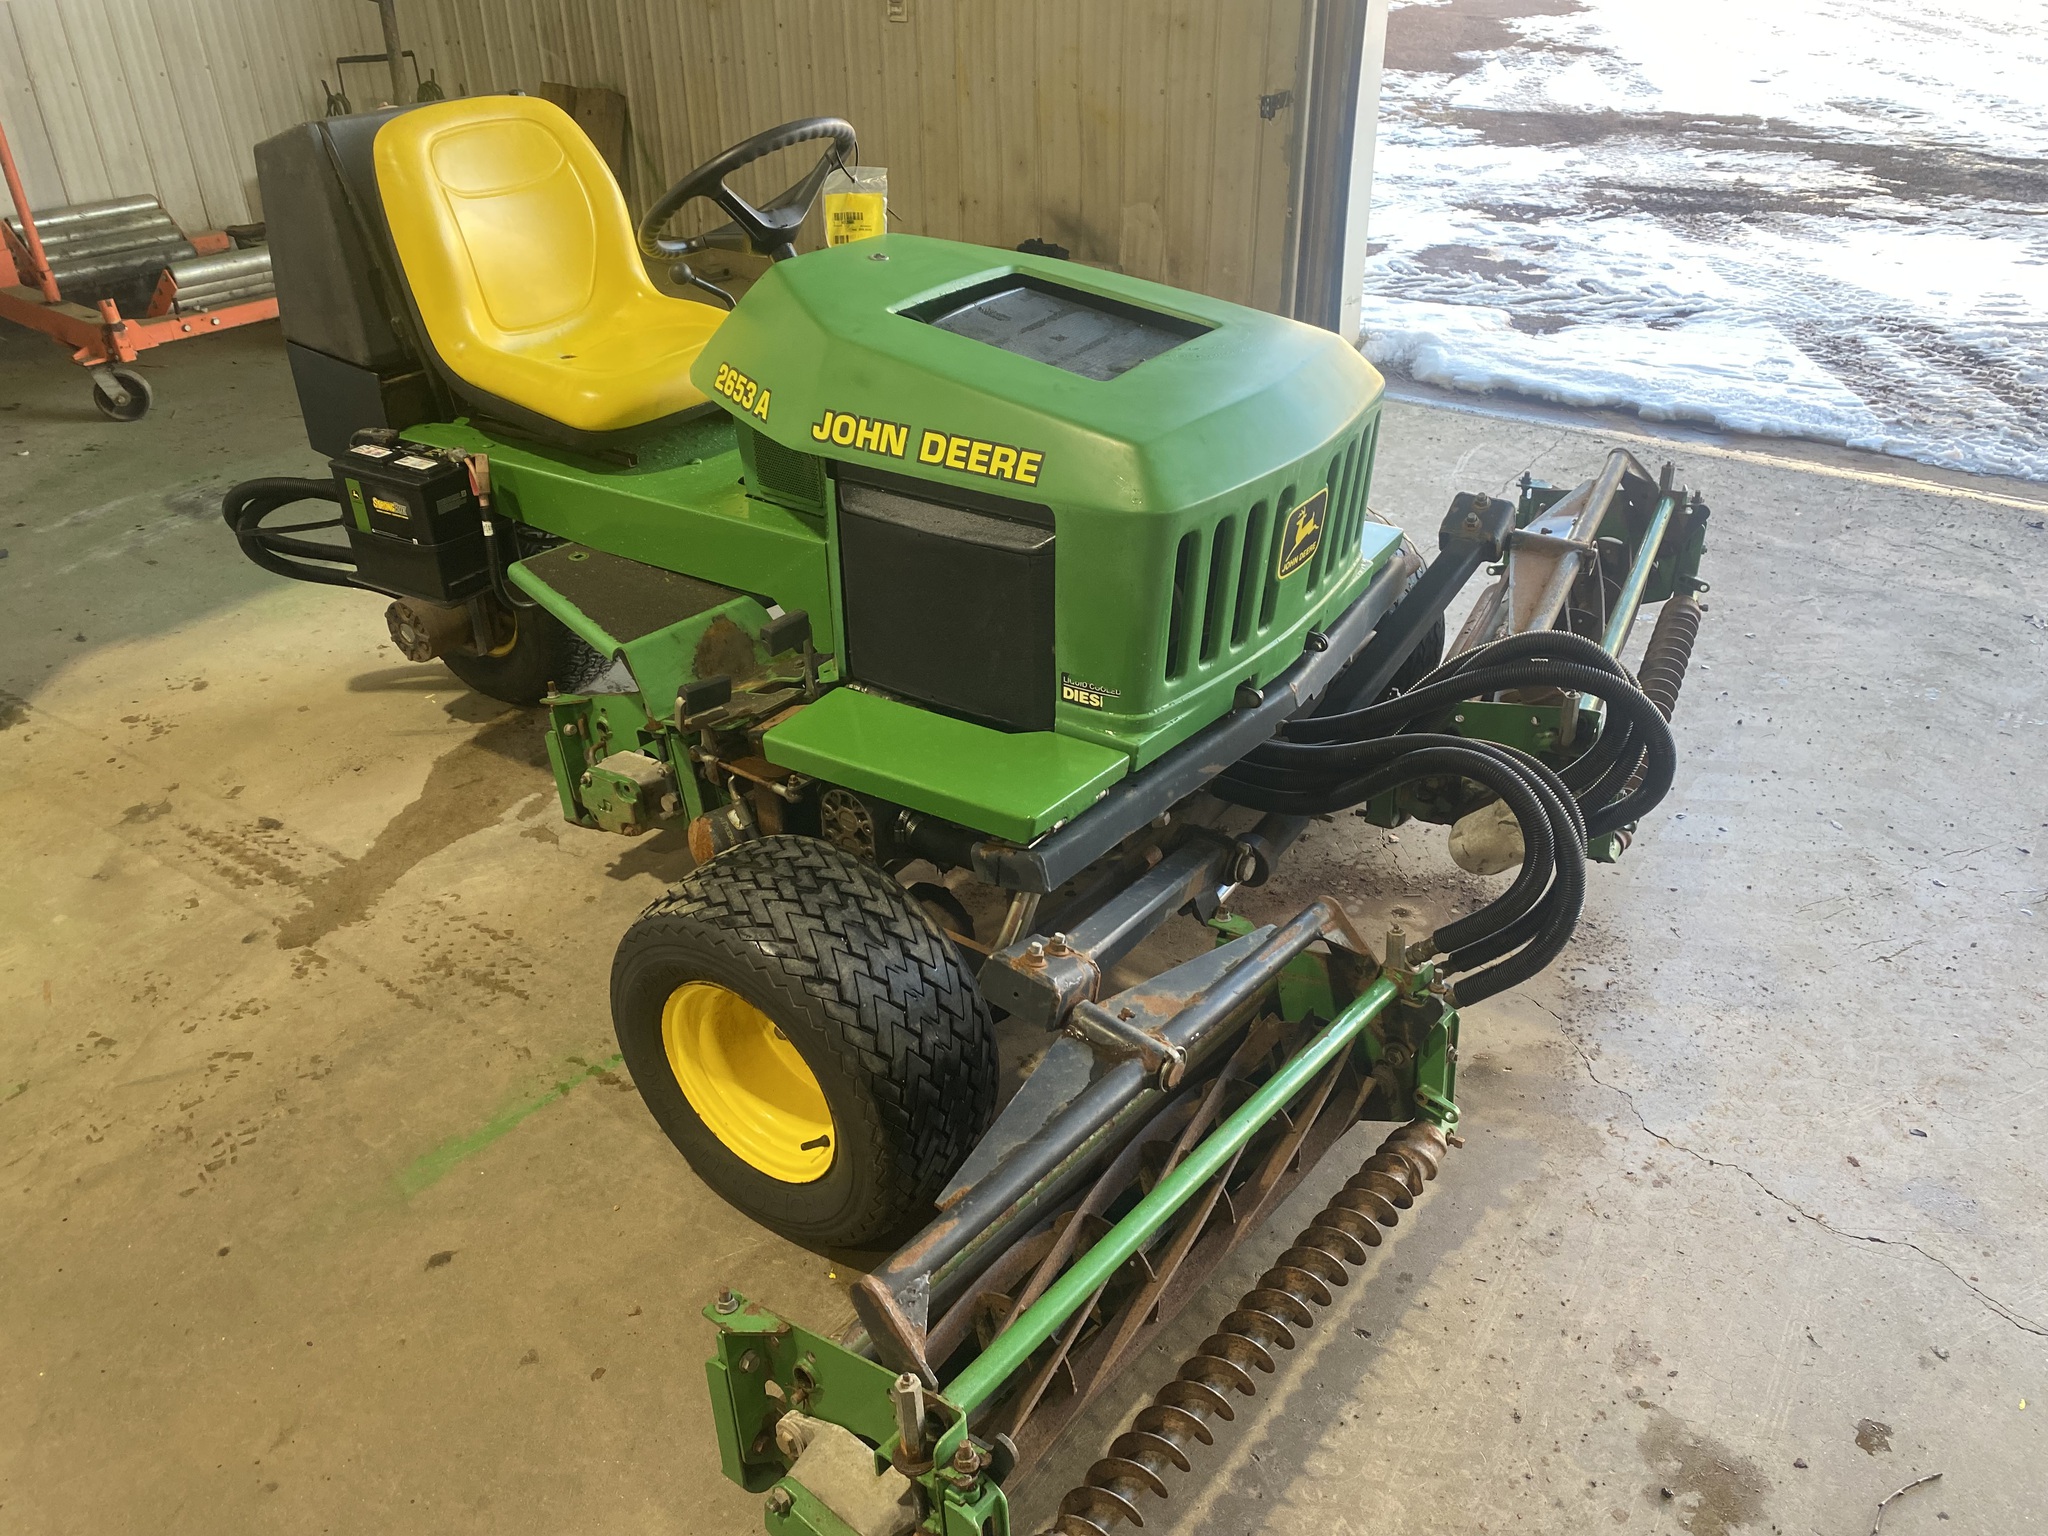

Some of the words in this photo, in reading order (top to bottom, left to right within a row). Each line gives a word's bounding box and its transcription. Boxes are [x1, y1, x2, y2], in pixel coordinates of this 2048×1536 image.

[812, 410, 909, 457] JOHN
[918, 430, 1044, 485] DEERE
[1281, 555, 1299, 573] JOHN
[1299, 541, 1317, 561] DEERE
